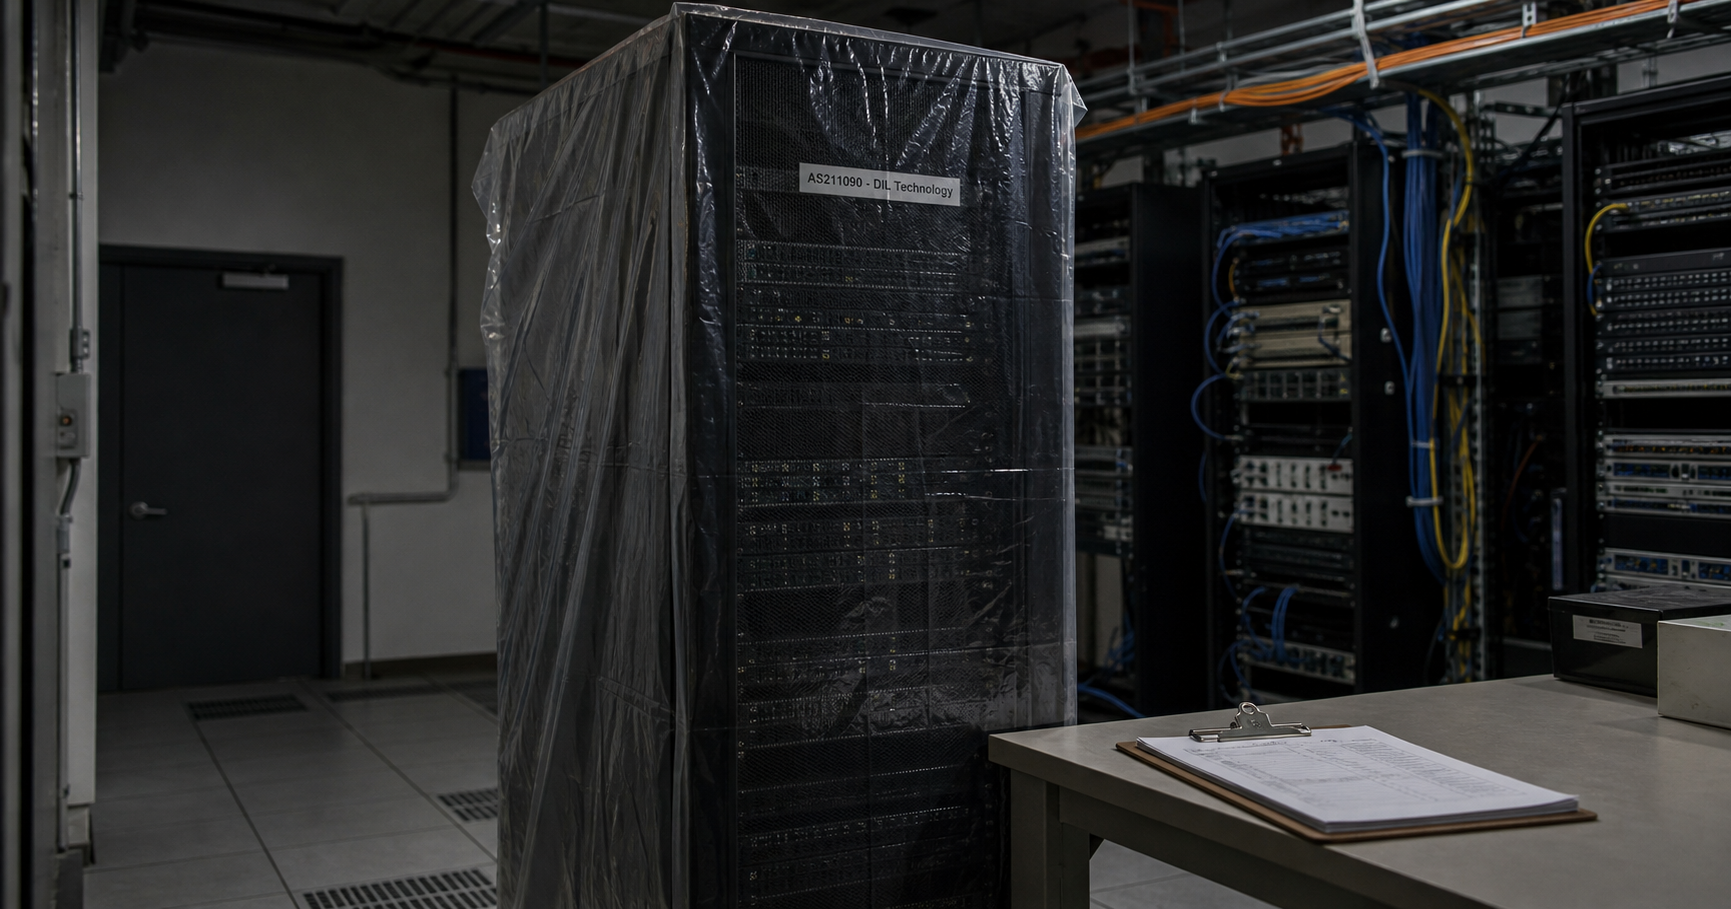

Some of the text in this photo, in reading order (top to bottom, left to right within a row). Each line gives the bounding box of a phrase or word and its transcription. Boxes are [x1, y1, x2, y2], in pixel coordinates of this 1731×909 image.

[807, 172, 862, 187] AS211090
[873, 179, 891, 190] DIL
[894, 181, 953, 198] Technology
